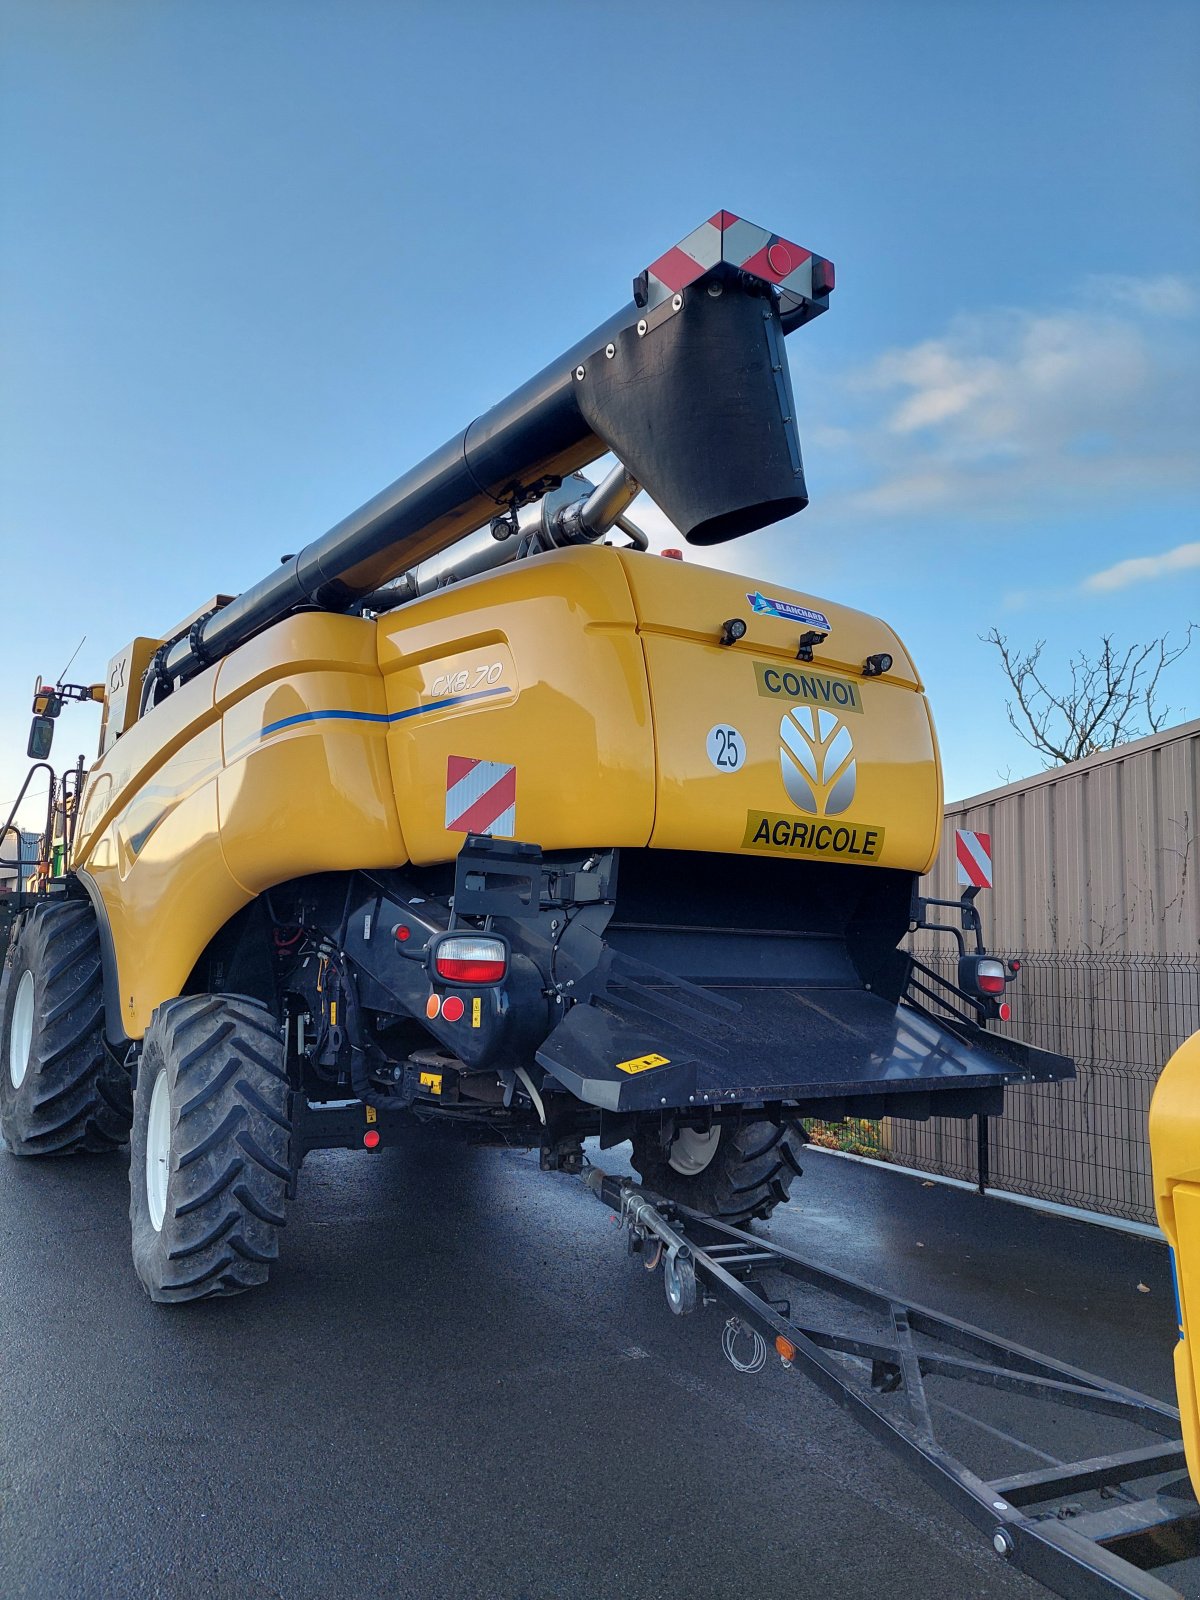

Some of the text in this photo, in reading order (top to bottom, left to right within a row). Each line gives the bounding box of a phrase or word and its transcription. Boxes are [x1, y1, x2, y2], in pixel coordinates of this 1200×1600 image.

[775, 603, 824, 622] BLANCHARD
[431, 662, 503, 697] CX8.70
[764, 669, 856, 706] CONVOI
[715, 729, 738, 767] 25
[752, 818, 878, 855] AGRICOLE
